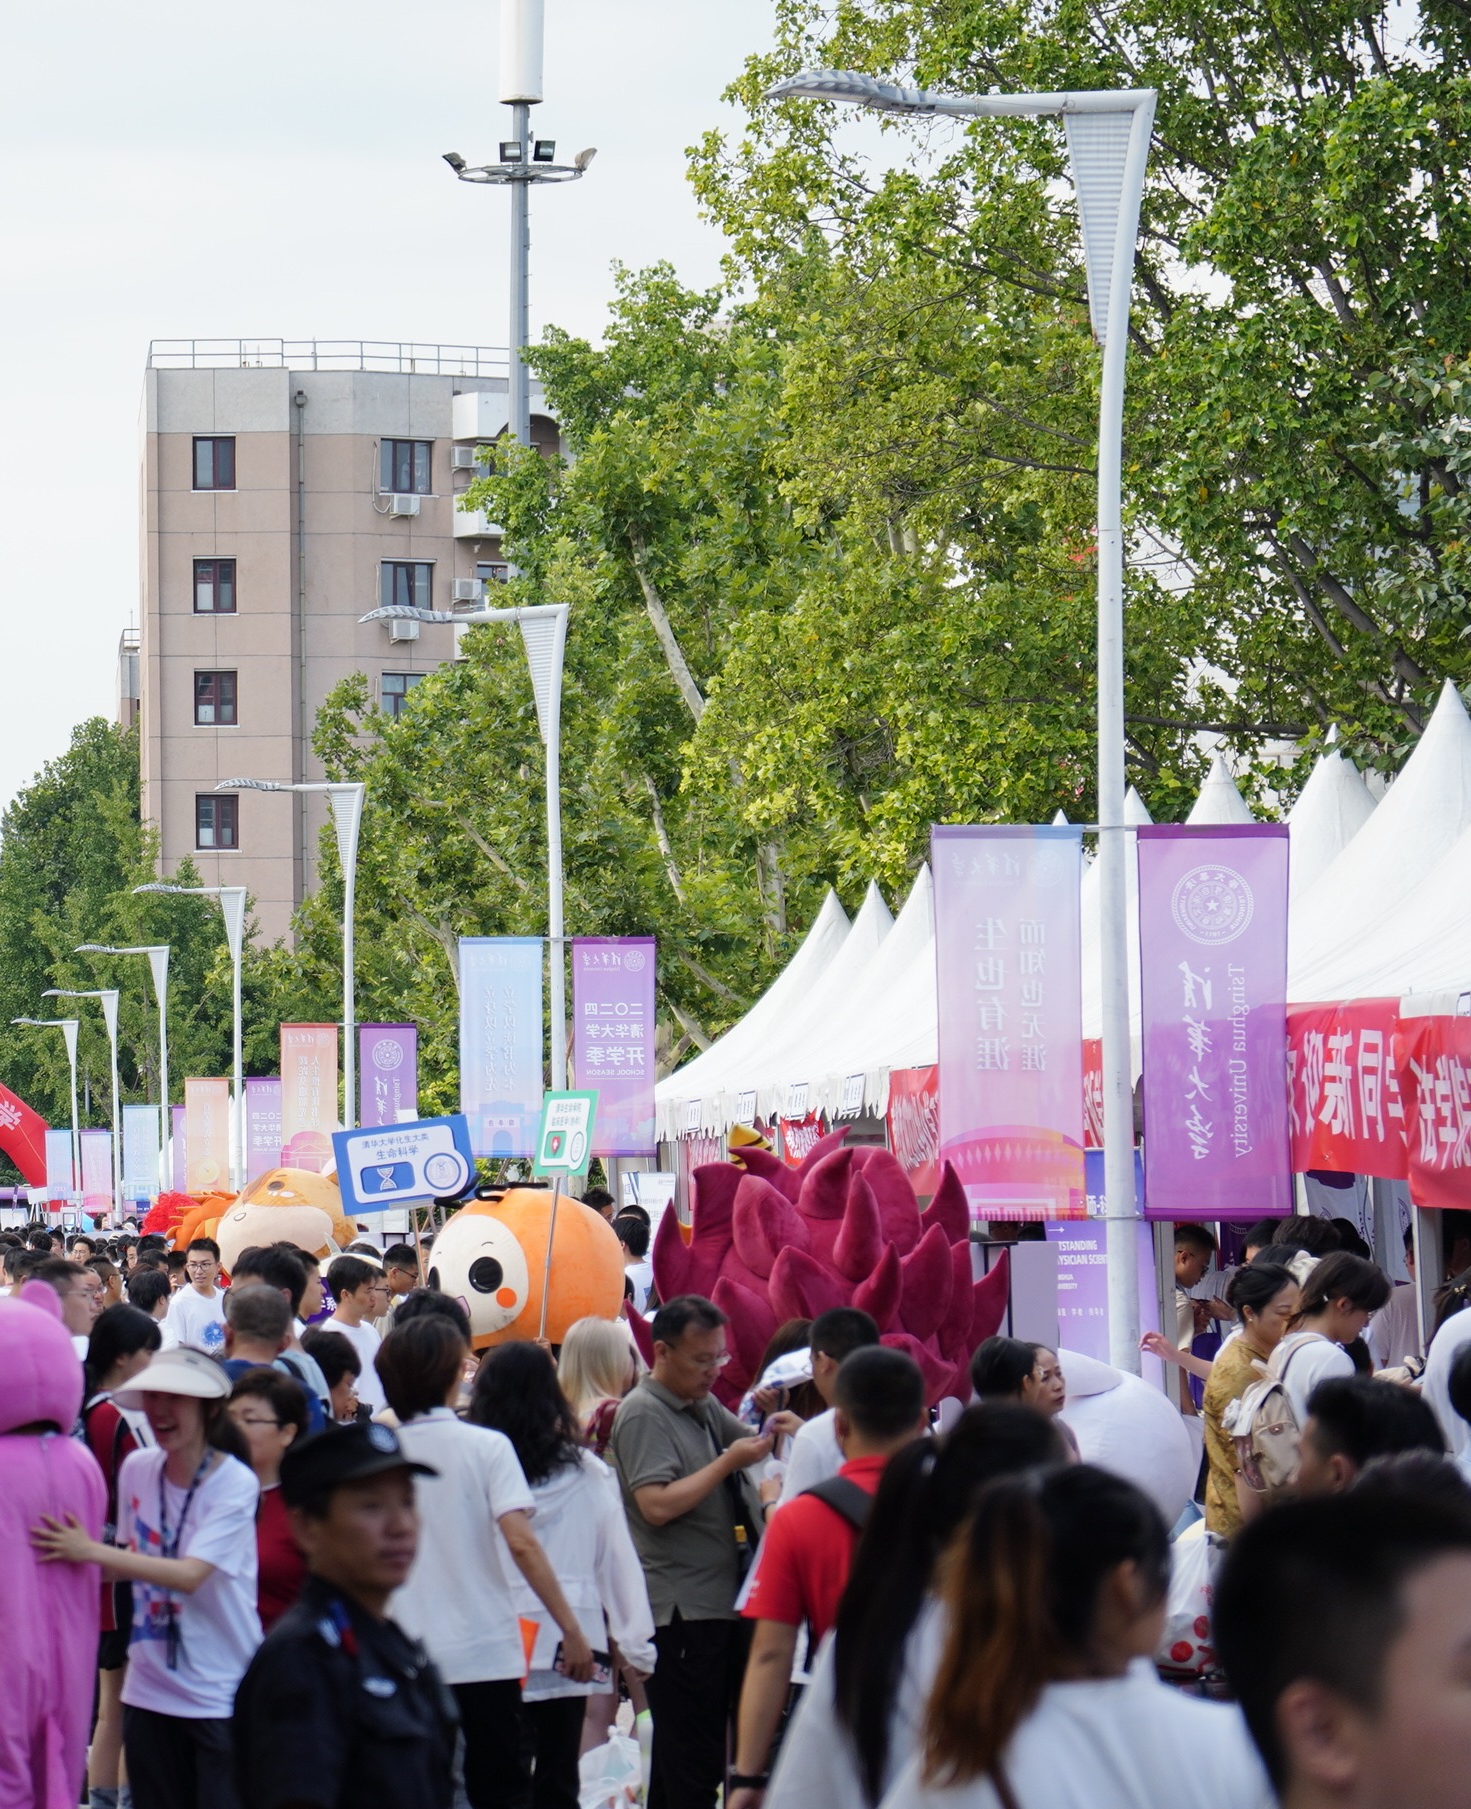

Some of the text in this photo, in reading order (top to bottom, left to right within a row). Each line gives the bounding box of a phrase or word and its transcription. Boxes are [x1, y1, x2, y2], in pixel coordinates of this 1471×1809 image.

[362, 1133, 430, 1149] 清华大学化生大类
[376, 1145, 419, 1160] 生命科学
[1058, 1240, 1098, 1251] TSTANDING
[1088, 1254, 1108, 1265] SCIENT
